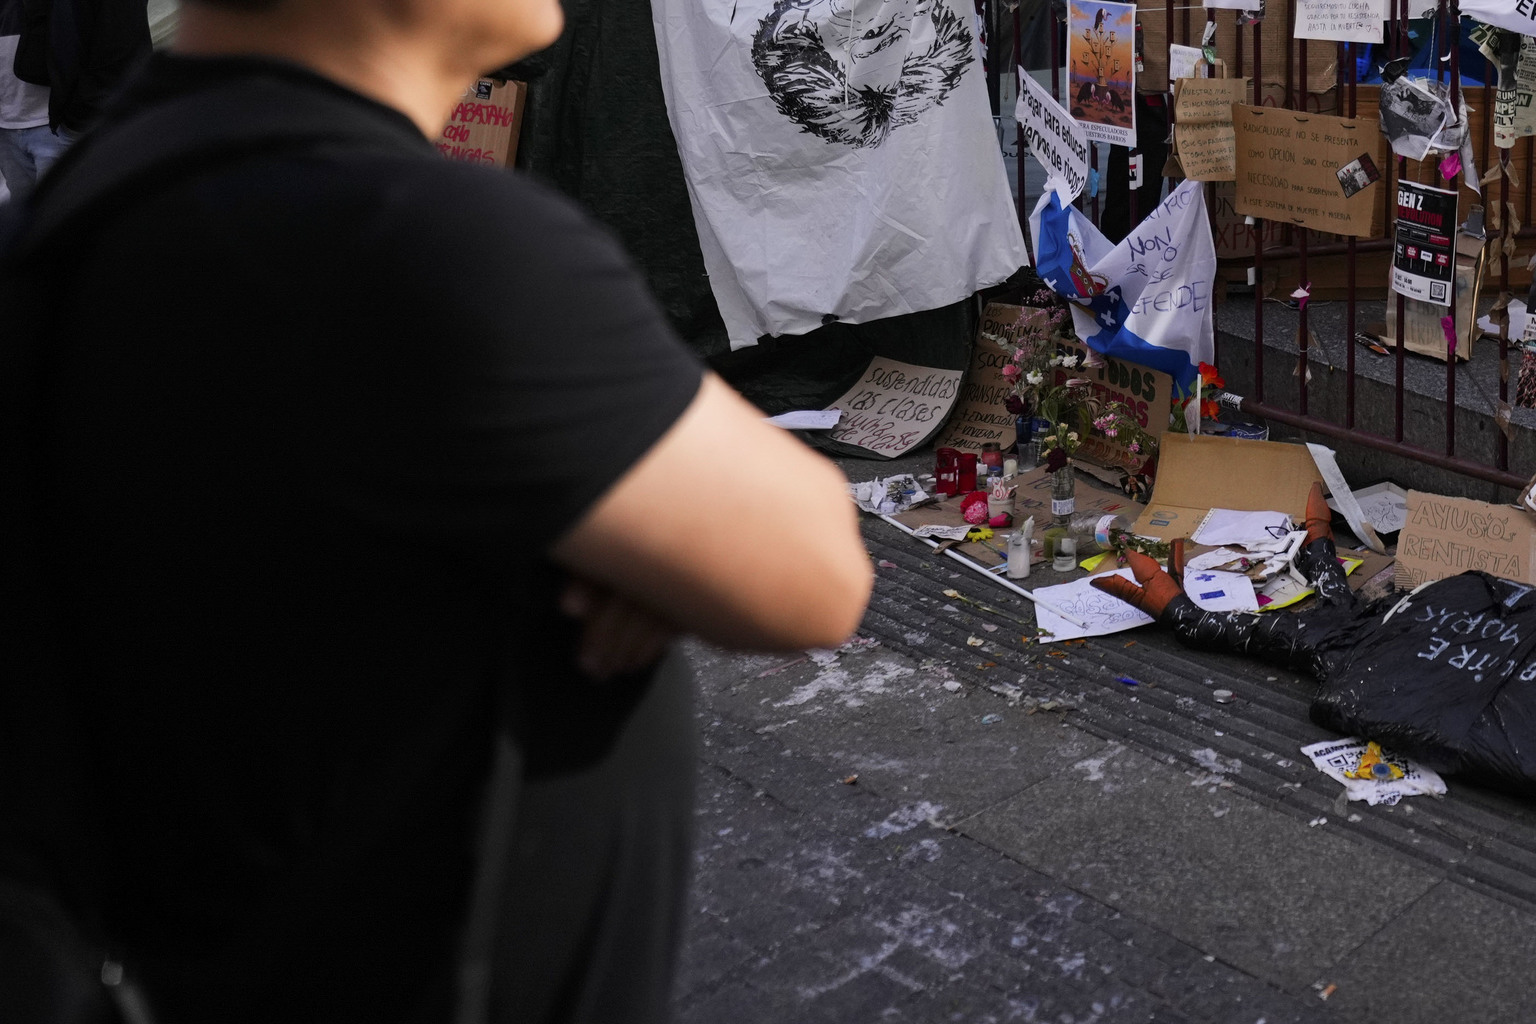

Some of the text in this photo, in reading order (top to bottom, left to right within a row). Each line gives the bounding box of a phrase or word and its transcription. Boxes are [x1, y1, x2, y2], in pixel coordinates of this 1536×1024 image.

[1022, 79, 1087, 164] Pagar para educar
[1091, 124, 1128, 136] ESPECULADORES
[1107, 134, 1126, 143] BARRIOS
[1243, 122, 1359, 147] RADICALIZARSE NO SE PRESENTA
[1051, 152, 1062, 172] de
[1248, 150, 1339, 169] COMO SINO COMO
[1248, 172, 1339, 198] NECESIDAD SOBREVIVIR
[1264, 199, 1351, 221] SISTEMA MUERTE MISERIA
[1398, 190, 1416, 209] GEN
[877, 397, 941, 422] clases
[1412, 501, 1510, 542] AYUSO
[1404, 534, 1520, 578] RENTISTA
